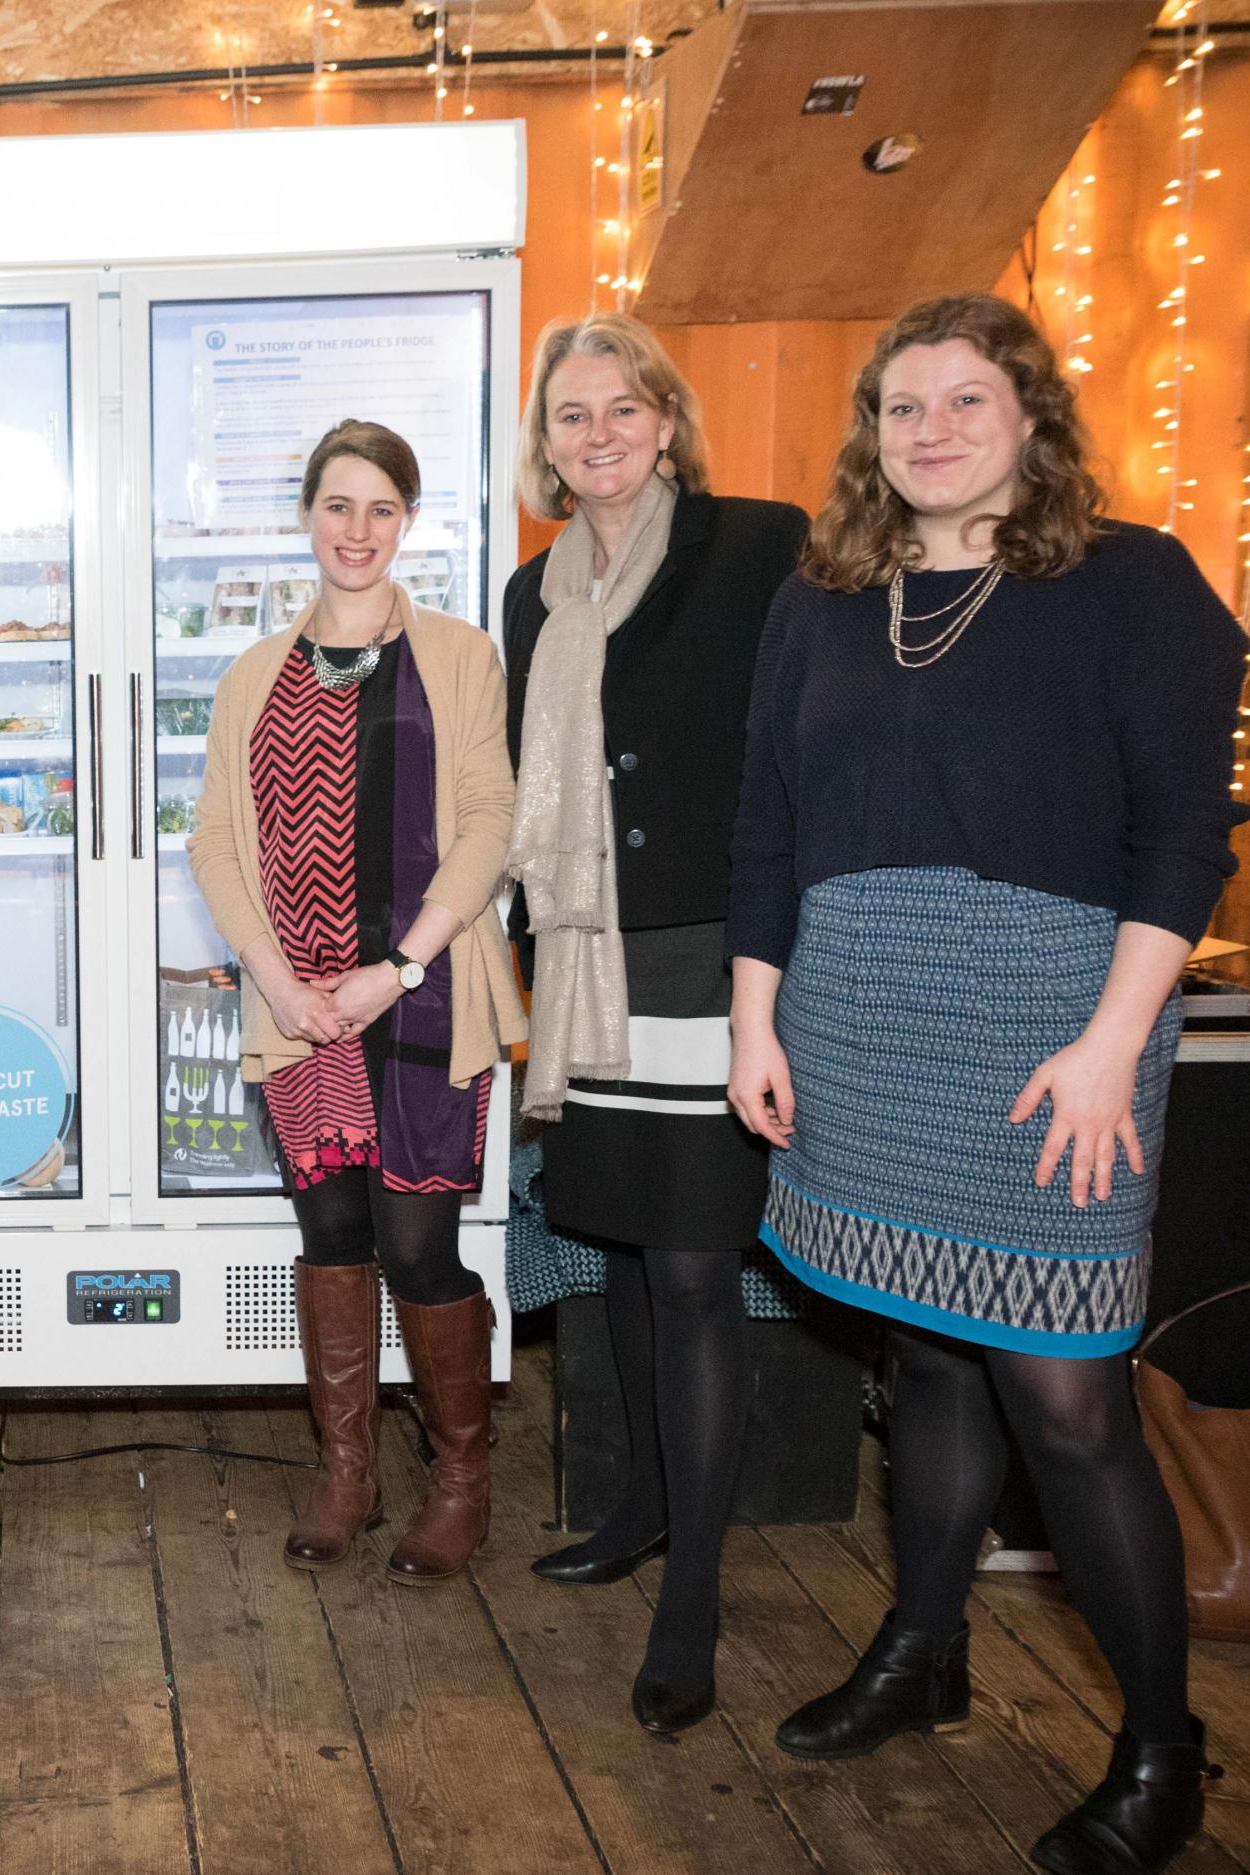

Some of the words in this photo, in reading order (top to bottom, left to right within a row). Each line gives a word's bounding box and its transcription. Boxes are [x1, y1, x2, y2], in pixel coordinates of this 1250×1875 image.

[235, 342, 256, 353] THE
[260, 341, 295, 353] STORY
[298, 340, 313, 351] OF
[317, 339, 337, 350] THE
[341, 337, 392, 349] PEOPLE'S
[395, 336, 435, 347] FRIDGE
[75, 1272, 171, 1289] POLAR
[76, 1288, 172, 1297] REFRIGERATION
